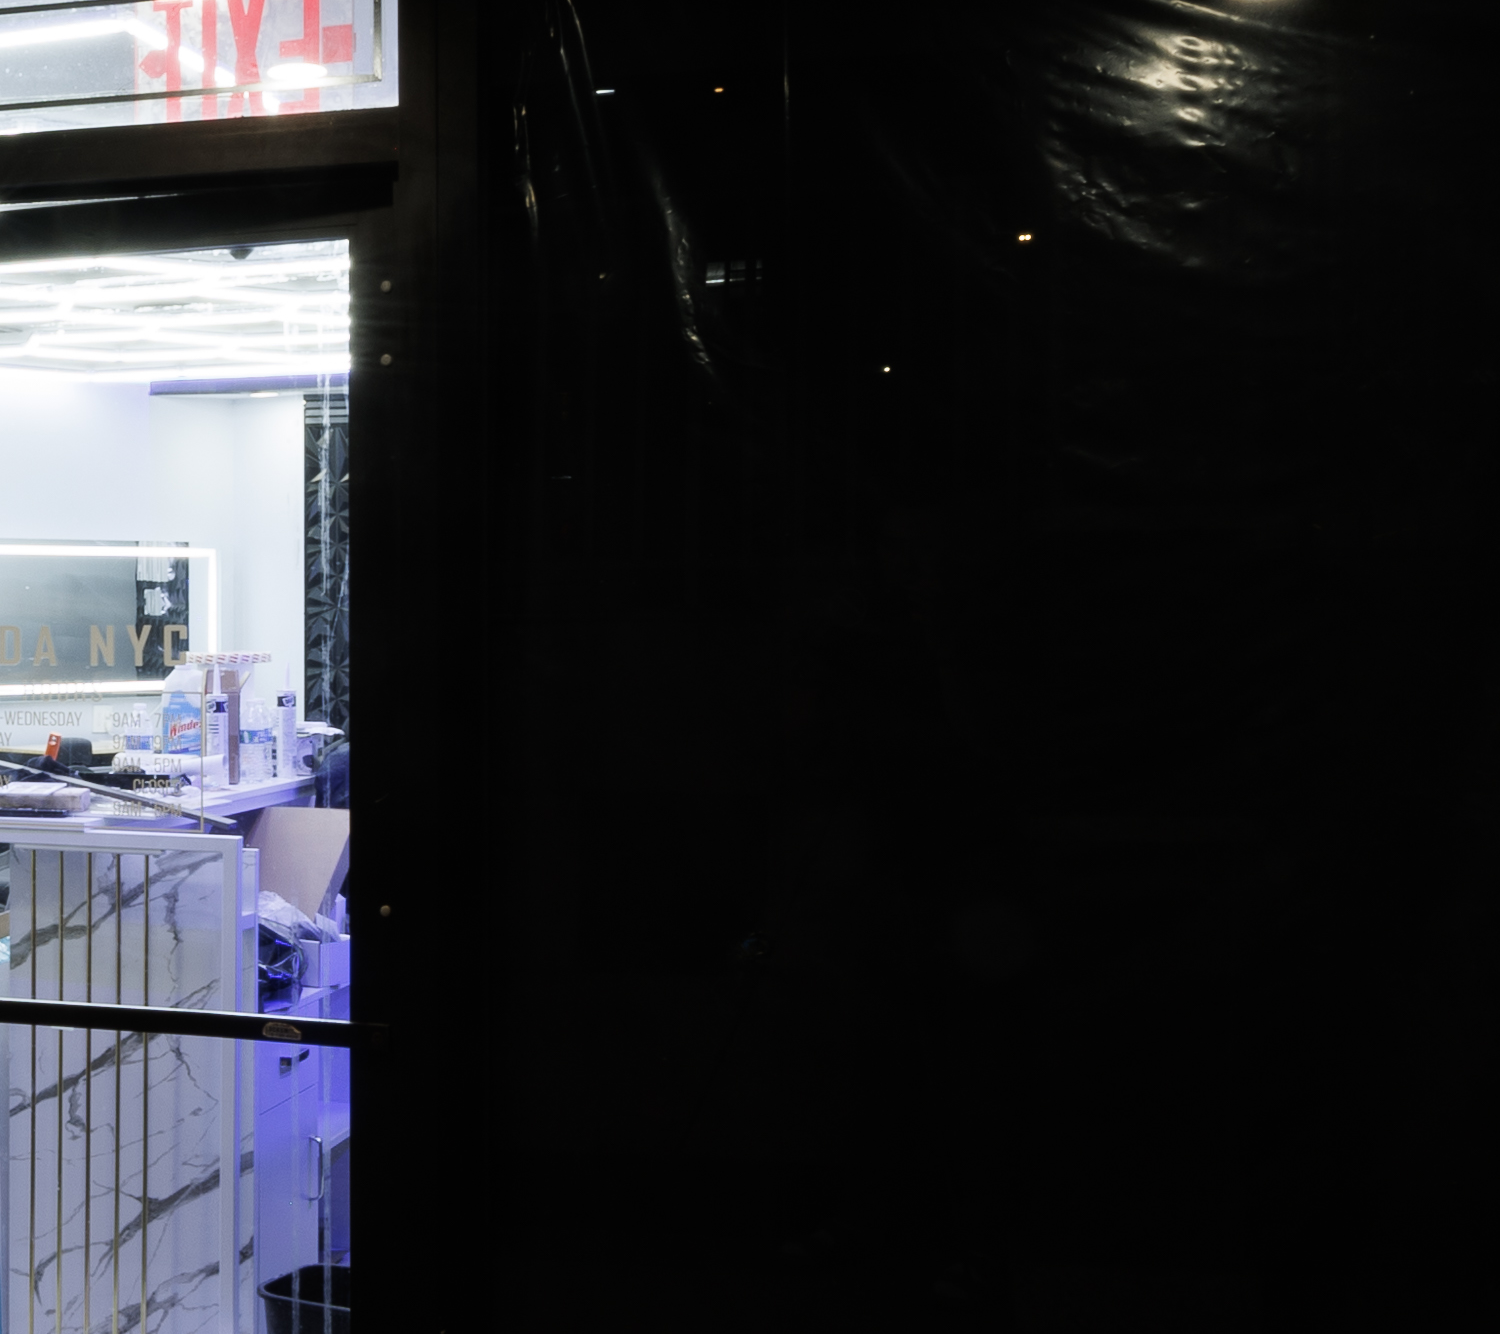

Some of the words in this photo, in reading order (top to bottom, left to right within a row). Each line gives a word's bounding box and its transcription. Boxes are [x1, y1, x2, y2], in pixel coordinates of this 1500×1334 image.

[90, 624, 188, 667] NYC
[112, 712, 141, 728] 9AM
[154, 713, 182, 728] 7PM
[154, 757, 182, 773] 5PM
